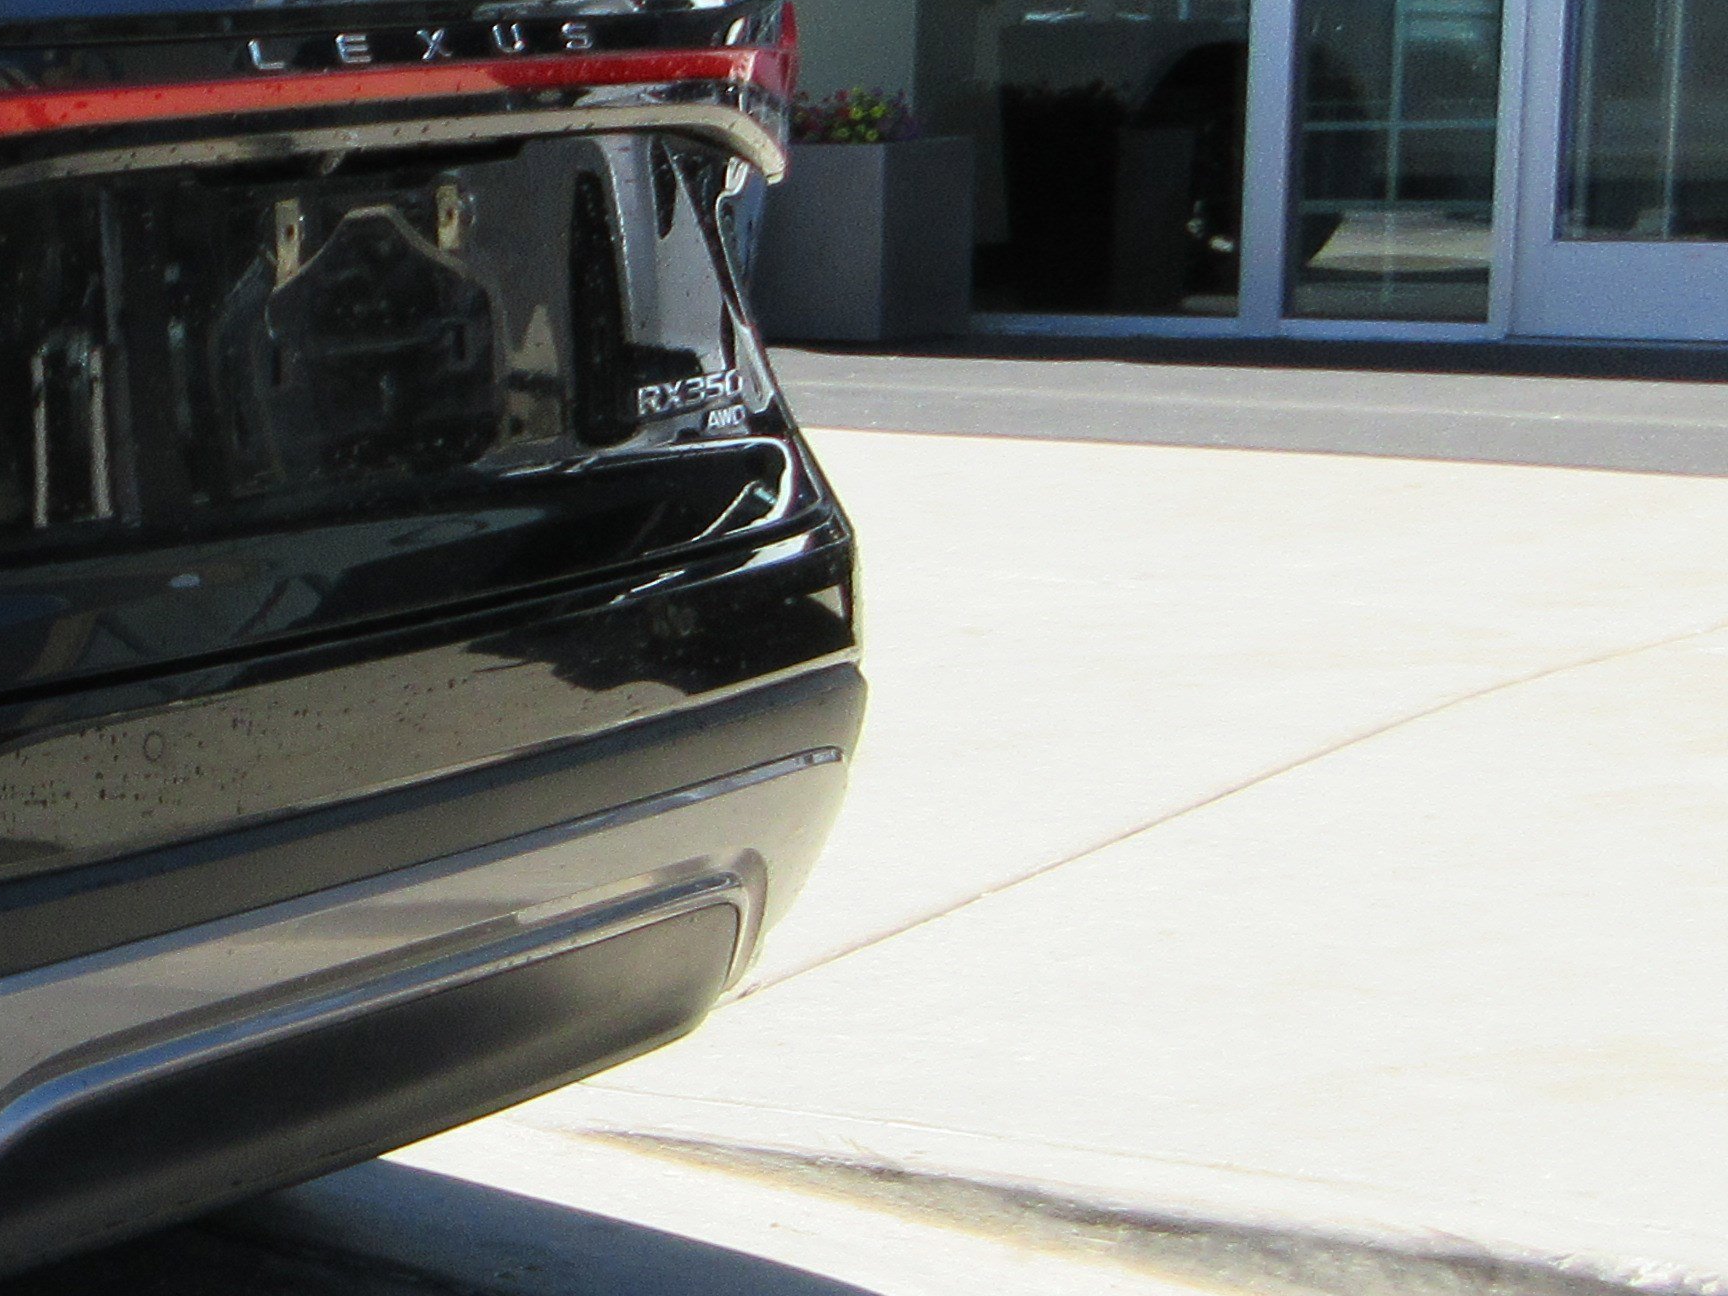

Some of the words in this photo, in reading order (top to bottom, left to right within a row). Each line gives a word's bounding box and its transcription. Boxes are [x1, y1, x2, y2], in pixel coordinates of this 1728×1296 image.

[247, 22, 594, 70] LEXUS
[638, 368, 744, 417] RX350
[707, 404, 747, 432] AWD
